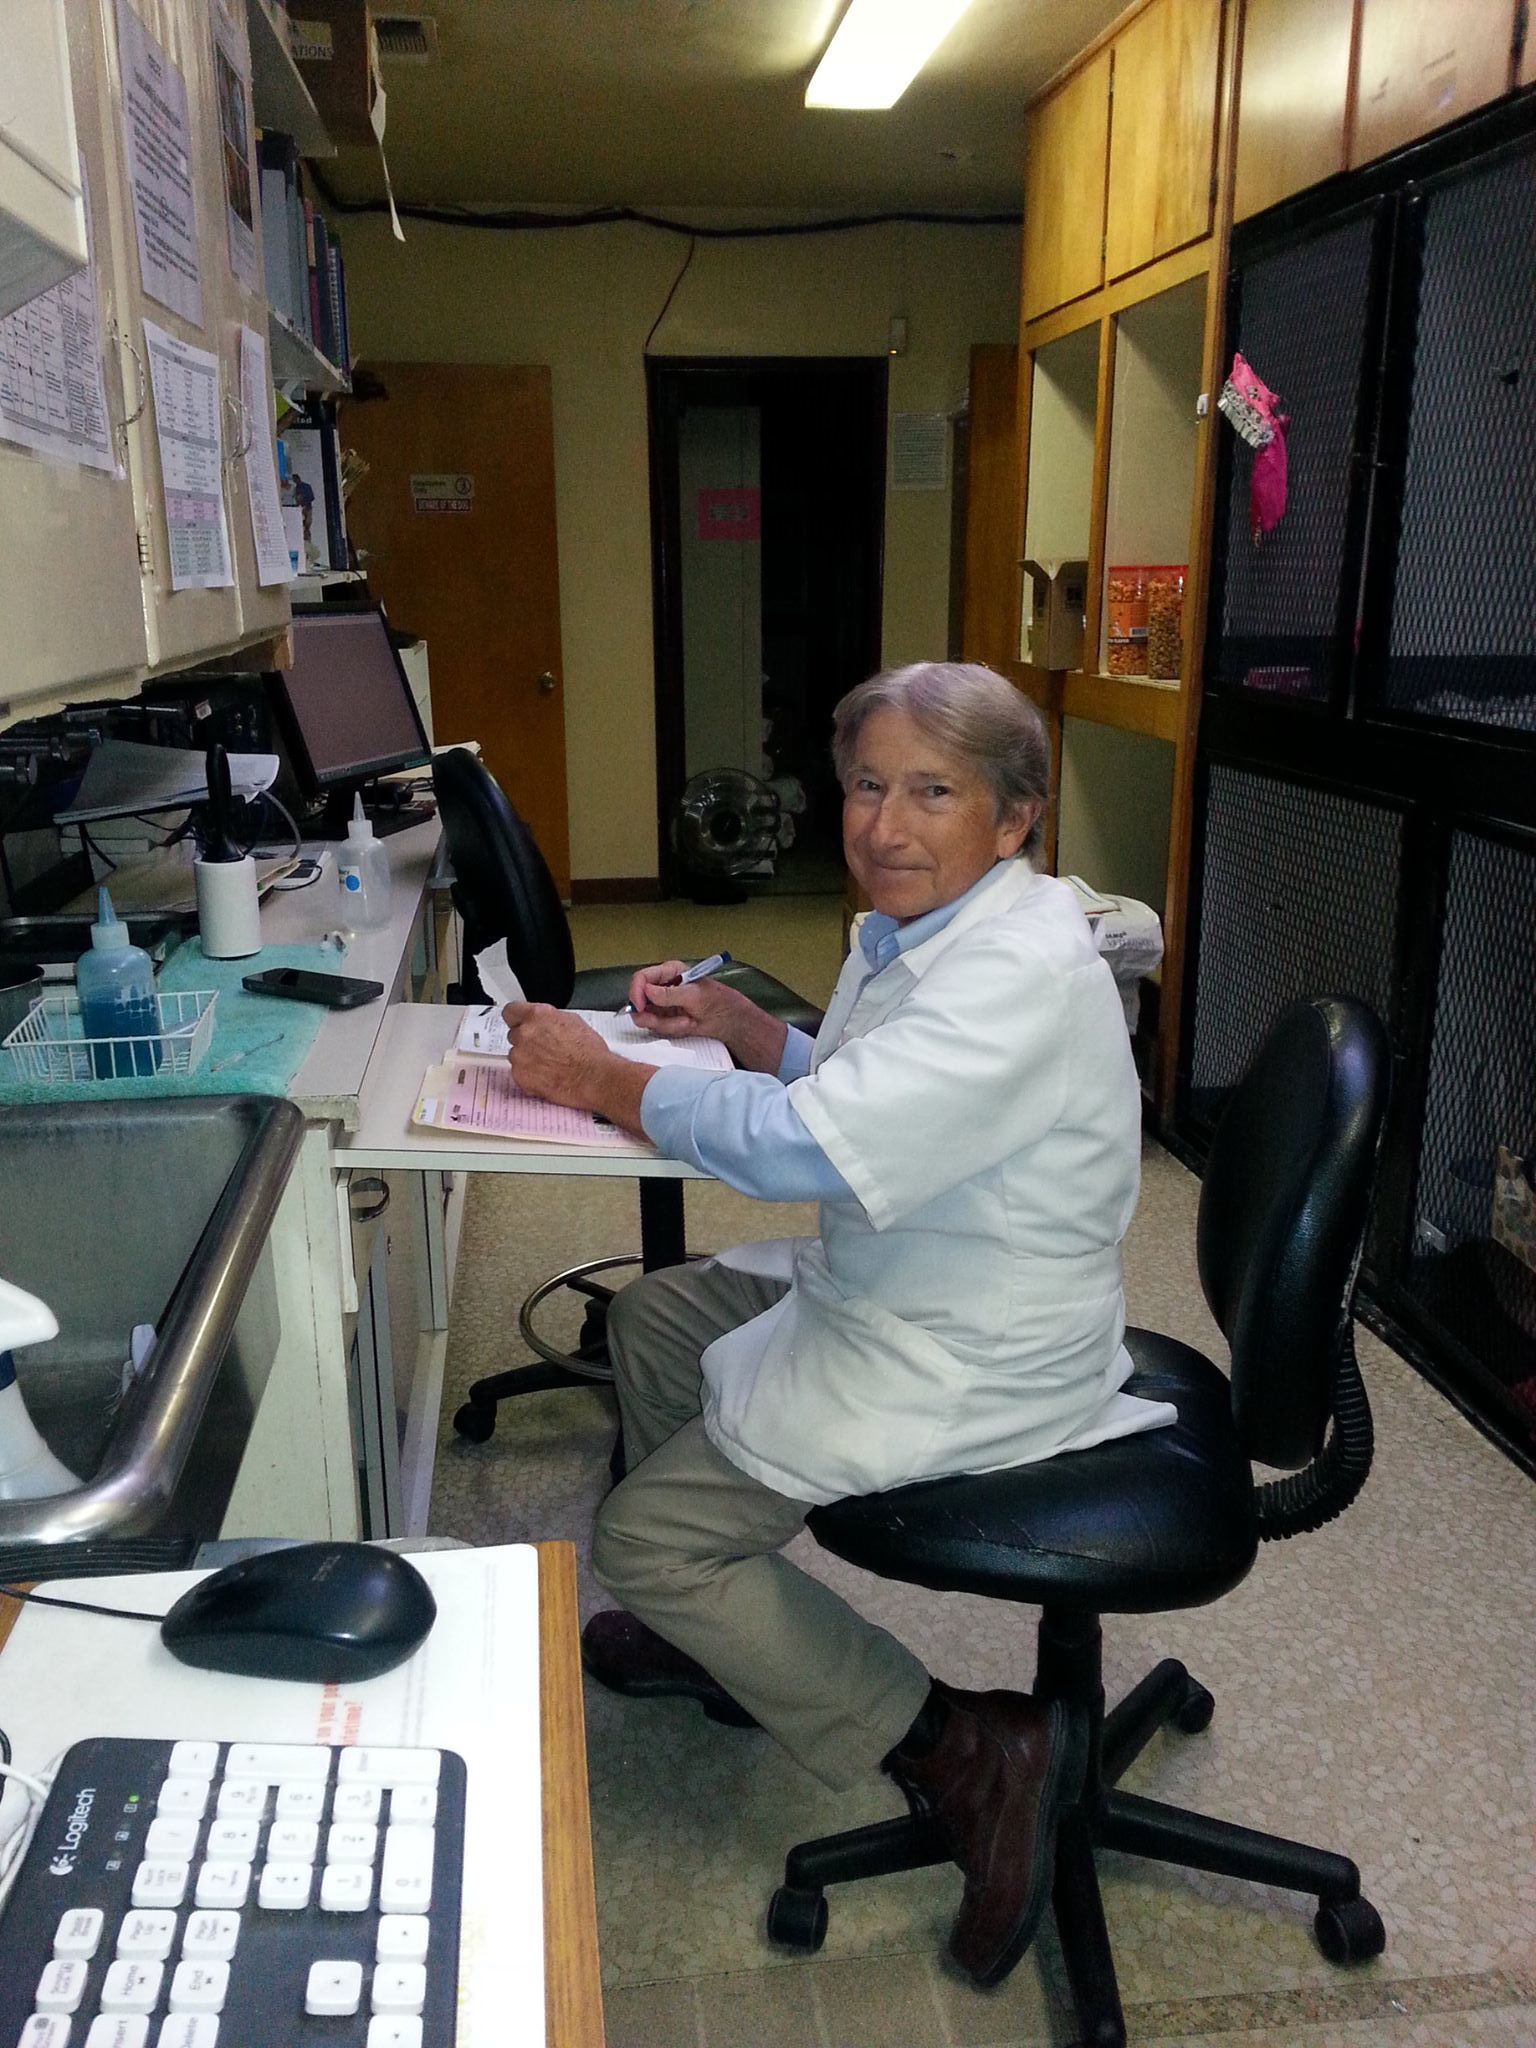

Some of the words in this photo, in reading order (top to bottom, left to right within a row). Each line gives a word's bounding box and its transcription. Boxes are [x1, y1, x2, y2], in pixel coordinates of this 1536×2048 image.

[57, 1787, 97, 1851] Logitech
[121, 1964, 140, 1996] Home
[188, 1969, 204, 1992] End
[112, 2019, 128, 2048] nsert
